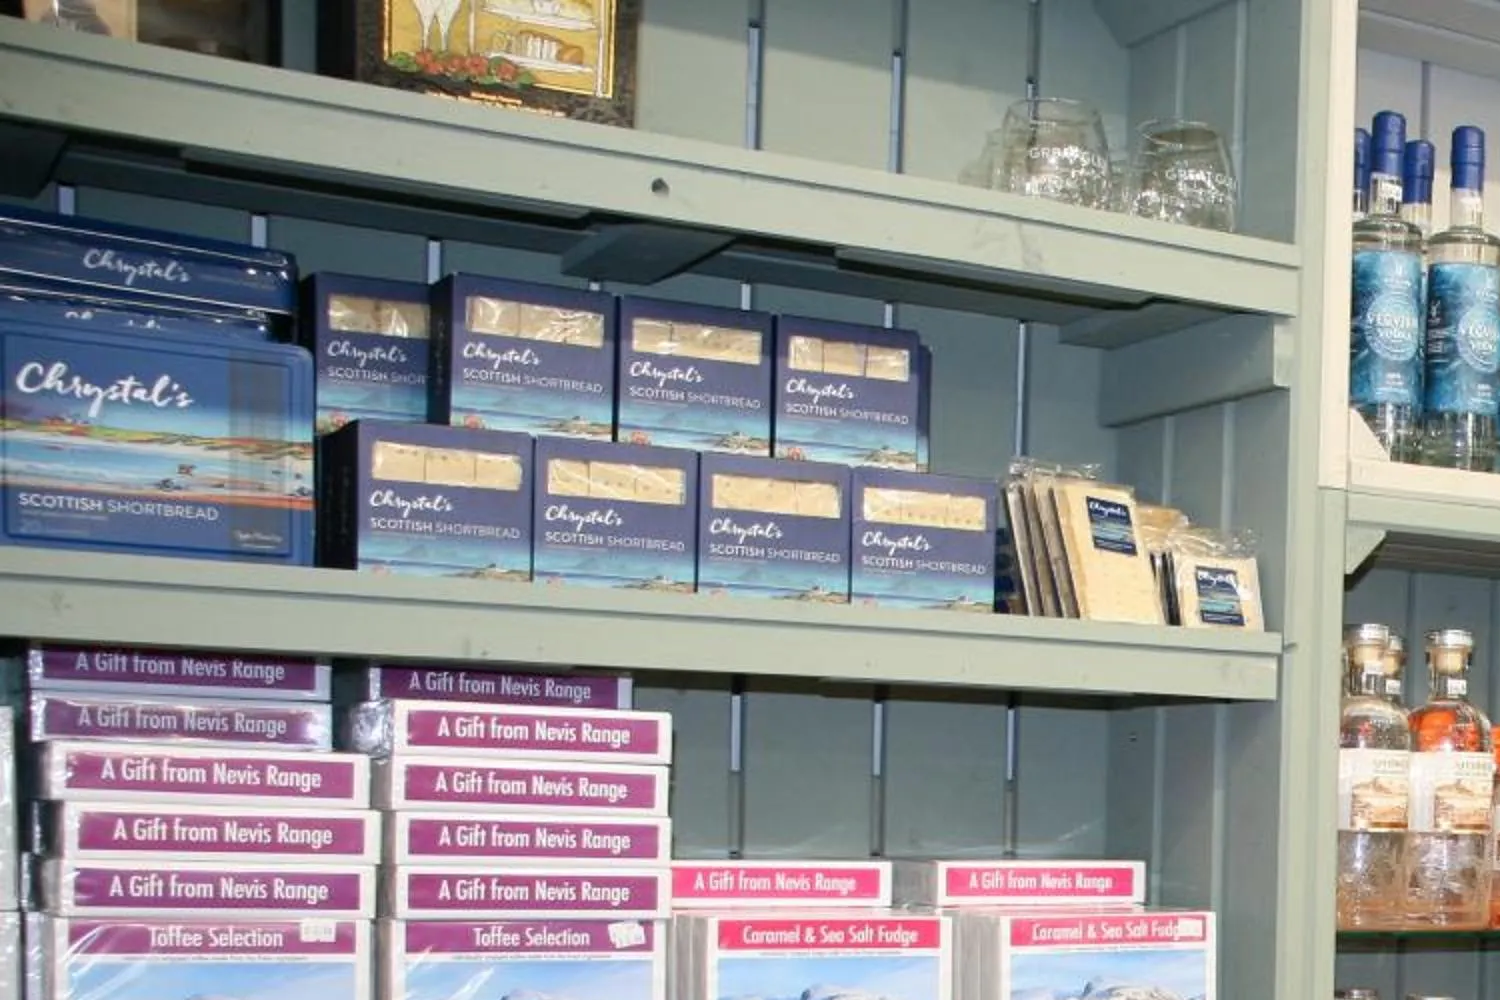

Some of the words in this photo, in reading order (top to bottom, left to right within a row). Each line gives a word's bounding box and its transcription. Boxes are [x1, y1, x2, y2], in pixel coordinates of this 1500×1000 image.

[83, 248, 191, 286] Chrystal's
[327, 341, 408, 368] Chrystal's
[463, 341, 542, 369] Chrystal's
[327, 366, 388, 382] SCOTTISH
[463, 366, 522, 386] SCOTTISH
[522, 375, 605, 394] SHORTBREAD
[629, 361, 704, 385] Chrystal's
[16, 360, 194, 417] Chrystal's
[629, 385, 686, 402] SCOTTISH
[687, 393, 762, 410] SHORTBREAD
[785, 378, 856, 402] Chrystal's
[785, 402, 838, 418] SCOTTISH
[837, 408, 910, 426] SHORTBREAD
[18, 492, 104, 513] SCOTTISH
[106, 501, 220, 522] SHORTBREAD
[369, 489, 454, 518] Chrystal's
[370, 517, 434, 534] SCOTTISH
[436, 523, 521, 540] SHORTBREAD
[545, 505, 624, 531] Chrystal's
[709, 518, 783, 541] Chrystal's
[545, 531, 604, 546] SCOTTISH
[607, 535, 686, 553] SHORTBREAD
[709, 542, 766, 559] SCOTTISH
[766, 549, 842, 564] SHORTBREAD
[862, 531, 933, 556] Chrystal's
[861, 555, 914, 570] SCOTTISH
[914, 560, 987, 576] SHORTBREAD
[75, 653, 89, 671] A
[95, 653, 127, 672] Gift
[133, 655, 175, 676] from
[181, 659, 227, 678] Nevis
[232, 660, 285, 685] Range
[408, 672, 421, 691] A
[425, 671, 454, 693] Gift
[458, 673, 495, 695] from
[500, 677, 540, 697] Nevis
[545, 679, 592, 704] Range
[78, 708, 92, 727] A
[97, 707, 129, 728] Gift
[135, 709, 177, 730] from
[183, 712, 229, 732] Nevis
[234, 715, 287, 738] Range
[437, 717, 450, 738] A
[455, 715, 486, 739] Gift
[490, 717, 529, 741] from
[534, 721, 577, 742] Nevis
[581, 722, 632, 749] Range
[101, 760, 115, 780] A
[121, 758, 157, 781] Gift
[162, 760, 206, 784] from
[212, 763, 261, 786] Nevis
[266, 765, 322, 793] Range
[434, 772, 448, 793] A
[452, 770, 484, 794] Gift
[487, 772, 526, 796] from
[531, 775, 574, 798] Nevis
[577, 778, 628, 803] Range
[113, 818, 128, 840] A
[133, 816, 168, 841] Gift
[173, 818, 218, 843] from
[224, 821, 272, 845] Nevis
[277, 823, 333, 849] Range
[439, 826, 451, 847] A
[456, 824, 486, 848] Gift
[490, 825, 530, 849] from
[535, 828, 577, 850] Nevis
[581, 831, 631, 855] Range
[109, 876, 123, 898] A
[128, 874, 164, 898] Gift
[169, 875, 214, 899] from
[219, 879, 268, 900] Nevis
[273, 881, 329, 905] Range
[439, 880, 451, 901] A
[455, 877, 486, 901] Gift
[490, 879, 529, 901] from
[534, 882, 577, 902] Nevis
[581, 884, 631, 907] Range
[694, 873, 706, 891] A
[709, 871, 735, 892] Gift
[739, 872, 771, 892] from
[775, 873, 811, 893] Nevis
[815, 872, 857, 897] Range
[968, 872, 979, 890] A
[981, 870, 1004, 890] Gift
[1007, 871, 1037, 890] from
[1041, 872, 1073, 890] Nevis
[1075, 872, 1114, 893] Range
[148, 925, 203, 948] Toffee
[208, 925, 284, 948] Selection
[472, 927, 522, 948] Toffee
[525, 927, 591, 948] Selection
[743, 925, 801, 945] Caramel
[804, 928, 816, 944] &
[821, 928, 845, 944] Sea
[849, 925, 874, 944] Salt
[878, 927, 919, 947] Fudge
[1032, 921, 1083, 941] Caramel
[1088, 923, 1098, 939] &
[1101, 921, 1123, 939] Sea
[1126, 918, 1149, 938] Salt
[1152, 918, 1182, 941] Fudg
